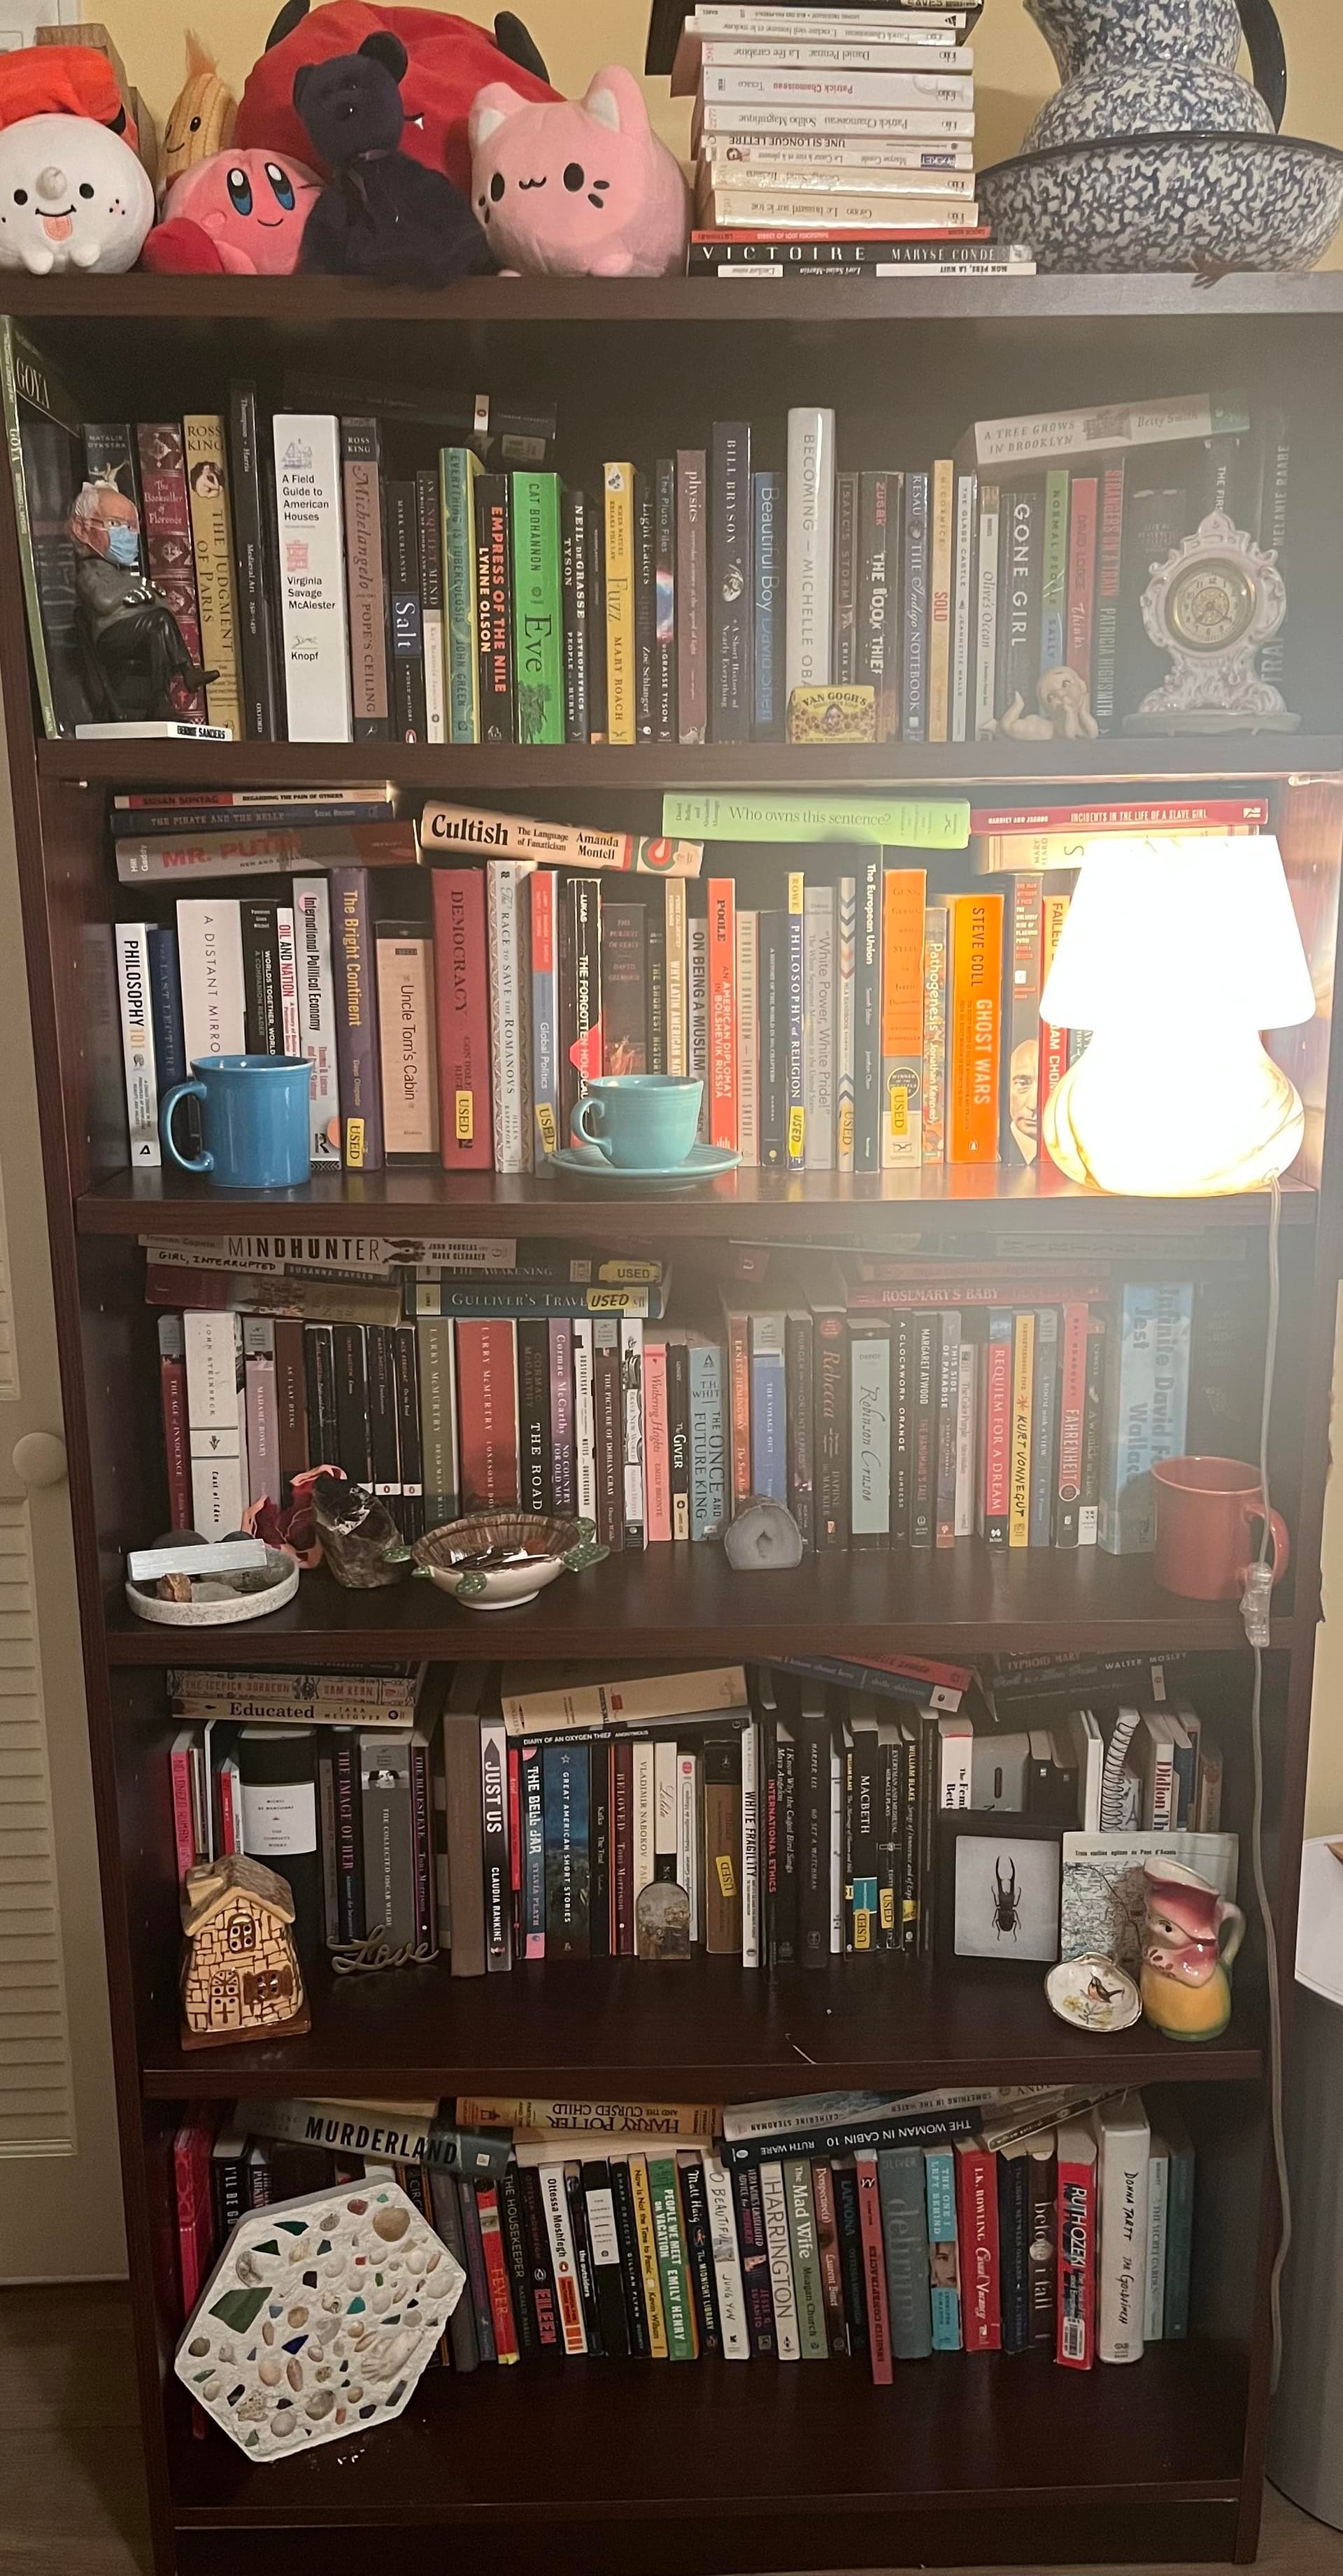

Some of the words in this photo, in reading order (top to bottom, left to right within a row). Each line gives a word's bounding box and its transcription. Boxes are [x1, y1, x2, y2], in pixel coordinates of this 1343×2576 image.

[739, 113, 788, 126] Magnifique
[790, 116, 816, 127] Solibo
[825, 116, 876, 128] Chamoiseau
[879, 118, 907, 129] Patrick
[729, 136, 765, 146] LETTRE
[769, 137, 812, 147] LONGUE
[813, 138, 823, 147] SI
[824, 138, 845, 147] UNE
[702, 247, 865, 260] VICTOIRE
[891, 248, 944, 260] MARYSE
[283, 475, 289, 483] A
[291, 475, 315, 483] Field
[283, 487, 308, 496] Guide
[312, 488, 322, 496] to
[529, 483, 541, 504] CAT
[803, 434, 815, 531] BECOMING
[911, 476, 923, 515] RESAU
[283, 499, 329, 508] American
[685, 471, 701, 522] physics
[213, 510, 225, 546] THE
[285, 512, 319, 521] Houses
[352, 467, 371, 590] Michelangelo
[761, 488, 778, 569] Beautiful
[197, 541, 209, 567] OF
[492, 506, 505, 584] EMPRESS
[530, 508, 542, 571] BOHANNON
[1013, 504, 1030, 576] GONE
[478, 548, 490, 595] LYNNE
[911, 545, 921, 571] THE
[199, 571, 214, 623] PARIS
[287, 576, 322, 585] Virginia
[287, 589, 322, 598] Savage
[756, 576, 777, 612] Boy
[213, 553, 234, 651] JUDGMENT
[288, 601, 336, 609] McAlester
[493, 590, 504, 613] OF
[608, 578, 627, 622] Fuzz
[802, 559, 814, 646] MICHELLE
[906, 577, 925, 628] Indigo
[934, 592, 947, 622] SOLD
[395, 602, 417, 648] Salt
[481, 600, 490, 652] OLSON
[494, 619, 505, 650] THE
[1011, 591, 1028, 646] GIRL
[291, 652, 319, 661] Knopf
[524, 613, 552, 673] Eve
[614, 636, 623, 674] MARY
[364, 655, 376, 712] CEILING
[495, 655, 506, 692] NILE
[909, 632, 921, 711] NOTEBOOK
[614, 678, 623, 720] ROACH
[802, 694, 825, 706] VAN
[827, 692, 867, 706] GOGH'S
[432, 815, 509, 846] Cultish
[730, 806, 762, 820] Who
[766, 810, 800, 821] owns
[804, 809, 826, 822] this
[830, 813, 892, 826] sentence?
[518, 827, 531, 837] The
[534, 831, 569, 842] Language
[527, 839, 567, 851] Fanaticism
[576, 832, 619, 847] Amanda
[578, 846, 616, 860] Montell
[866, 864, 876, 882] The
[343, 891, 358, 913] The
[865, 885, 875, 932] European
[279, 925, 290, 939] OIL
[304, 897, 318, 953] International
[345, 918, 360, 958] Bright
[972, 907, 985, 948] STEVE
[280, 941, 292, 960] AND
[450, 890, 467, 1013] DEMOCRACY
[692, 932, 704, 952] ON
[865, 934, 875, 965] Union
[205, 934, 218, 996] DISTANT
[282, 963, 294, 996] NATION
[307, 955, 319, 992] Political
[692, 956, 705, 998] BEING
[971, 955, 984, 987] COLL
[125, 941, 143, 1026] PHILOSOPHY
[346, 964, 362, 1026] Continent
[306, 995, 320, 1031] Economy
[400, 985, 415, 1020] Uncle
[694, 1002, 705, 1011] A
[130, 1029, 145, 1049] 101
[208, 1006, 221, 1053] MIRRO
[975, 999, 993, 1051] GHOST
[402, 1025, 415, 1060] Tom's
[693, 1016, 706, 1070] MUSLIM
[403, 1065, 417, 1100] Cabin
[974, 1058, 991, 1104] WARS
[458, 1099, 469, 1133] USED
[894, 1094, 905, 1128] USED
[350, 1126, 360, 1159] USED
[159, 1251, 190, 1265] GIRL,
[194, 1256, 276, 1270] INTERRUPTED
[229, 1237, 380, 1260] MINDHUNTER
[618, 1268, 650, 1279] USED
[592, 1294, 629, 1307] USED
[993, 1350, 1004, 1413] REQUIEM
[712, 1412, 720, 1430] THE
[993, 1418, 1004, 1445] FOR
[1016, 1415, 1027, 1446] KURT
[530, 1423, 541, 1455] THE
[694, 1412, 706, 1474] FUTURE
[993, 1449, 1004, 1458] A
[1063, 1410, 1079, 1480] FAHRENHEIT
[709, 1435, 724, 1493] ONCE
[532, 1465, 542, 1510] ROAD
[695, 1480, 707, 1519] KING
[991, 1462, 1003, 1510] DREAM
[1014, 1451, 1025, 1517] VONNEGUT
[713, 1497, 722, 1517] AND
[229, 1702, 315, 1718] Educated
[485, 1761, 500, 1805] JUST
[1154, 1761, 1172, 1809] Didion
[744, 1791, 757, 1826] WHITE
[860, 1775, 869, 1833] MACBETH
[486, 1811, 502, 1833] US
[746, 1828, 757, 1877] FRAGILITY
[492, 1867, 500, 1903] CLAUDIA
[493, 1905, 502, 1941] RANKINE
[883, 1895, 893, 1923] USED
[546, 2116, 614, 2130] POTTER
[552, 2103, 592, 2114] CHILD
[595, 2104, 642, 2116] CURSED
[621, 2119, 679, 2131] HARRY
[947, 2120, 972, 2130] THE
[305, 2116, 456, 2161] MURDERLAND
[827, 2137, 840, 2147] 10
[844, 2130, 879, 2144] CABIN
[883, 2129, 895, 2139] IN
[898, 2122, 946, 2136] WOMAN
[761, 2143, 787, 2154] WARE
[790, 2141, 814, 2151] RUTH
[794, 2166, 803, 2182] The
[548, 2179, 560, 2212] Ottessa
[665, 2189, 676, 2222] PEOPLE
[793, 2184, 808, 2217] Mad
[1070, 2187, 1086, 2223] RUTH
[550, 2215, 566, 2257] Moshfegh
[669, 2226, 678, 2238] WE
[797, 2221, 813, 2258] Wife
[1070, 2228, 1086, 2266] OZEKI
[670, 2241, 681, 2264] MEET
[765, 2181, 793, 2319] HARRINGTON
[667, 2270, 679, 2301] EMILY
[672, 2305, 685, 2340] HENRY
